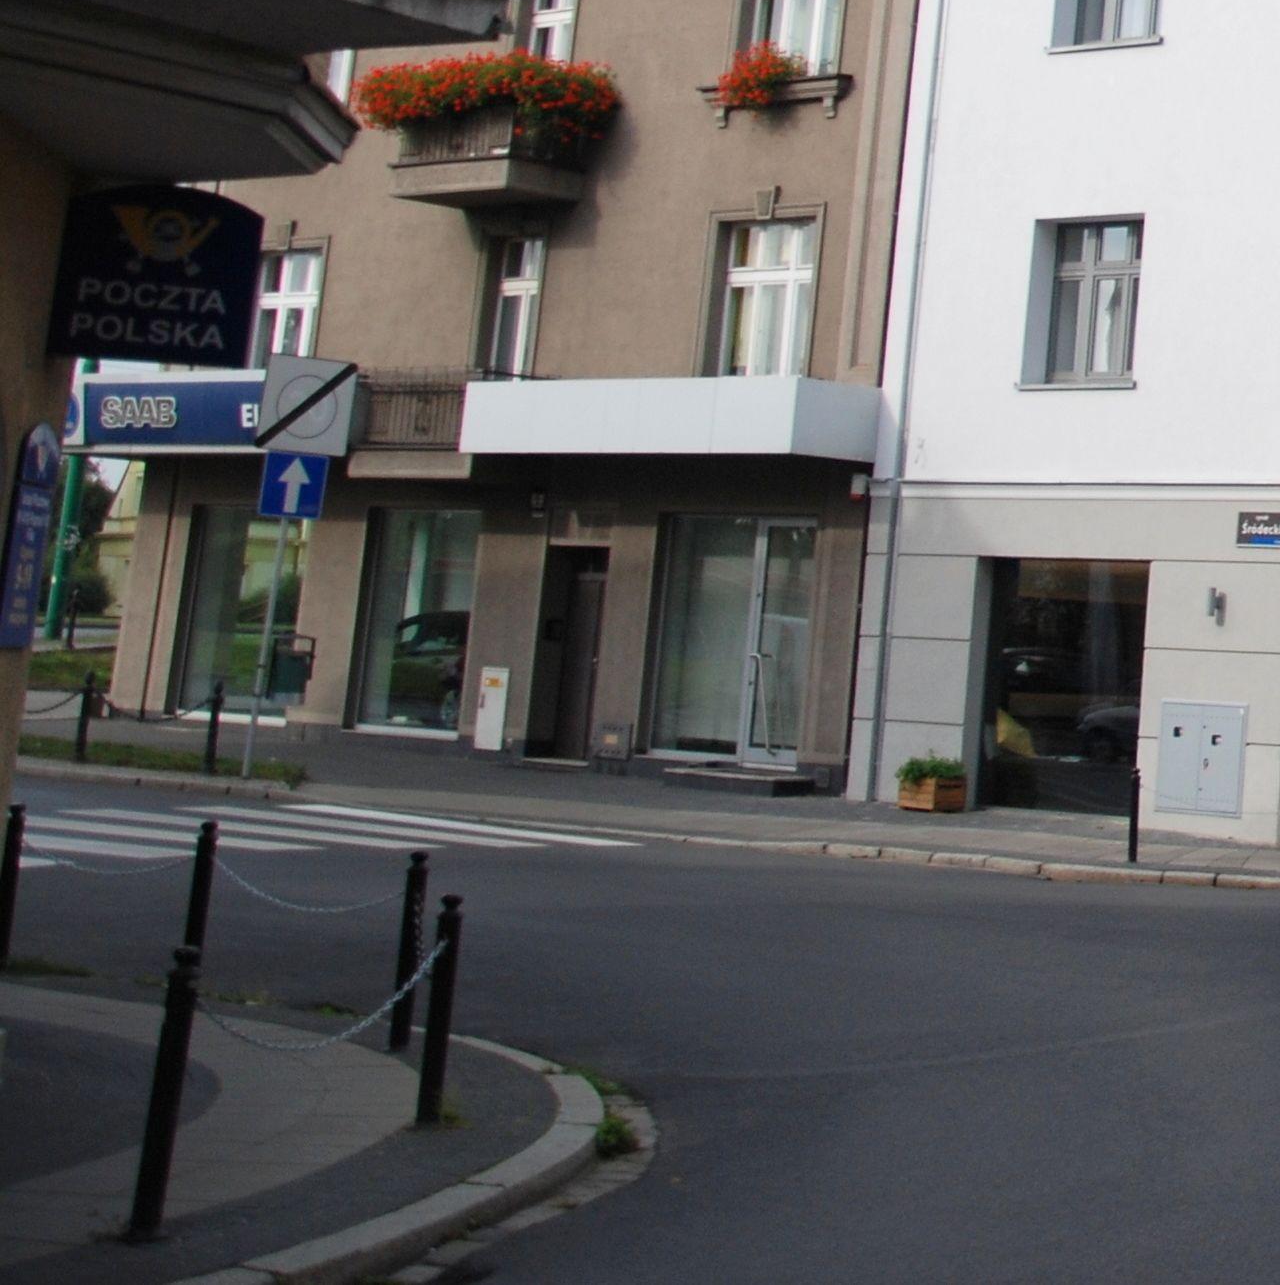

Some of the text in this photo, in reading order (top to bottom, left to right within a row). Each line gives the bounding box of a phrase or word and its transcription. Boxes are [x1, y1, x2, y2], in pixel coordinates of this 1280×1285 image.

[78, 277, 226, 315] POCZTA
[69, 312, 225, 351] POLSKA
[101, 396, 177, 428] SAAB
